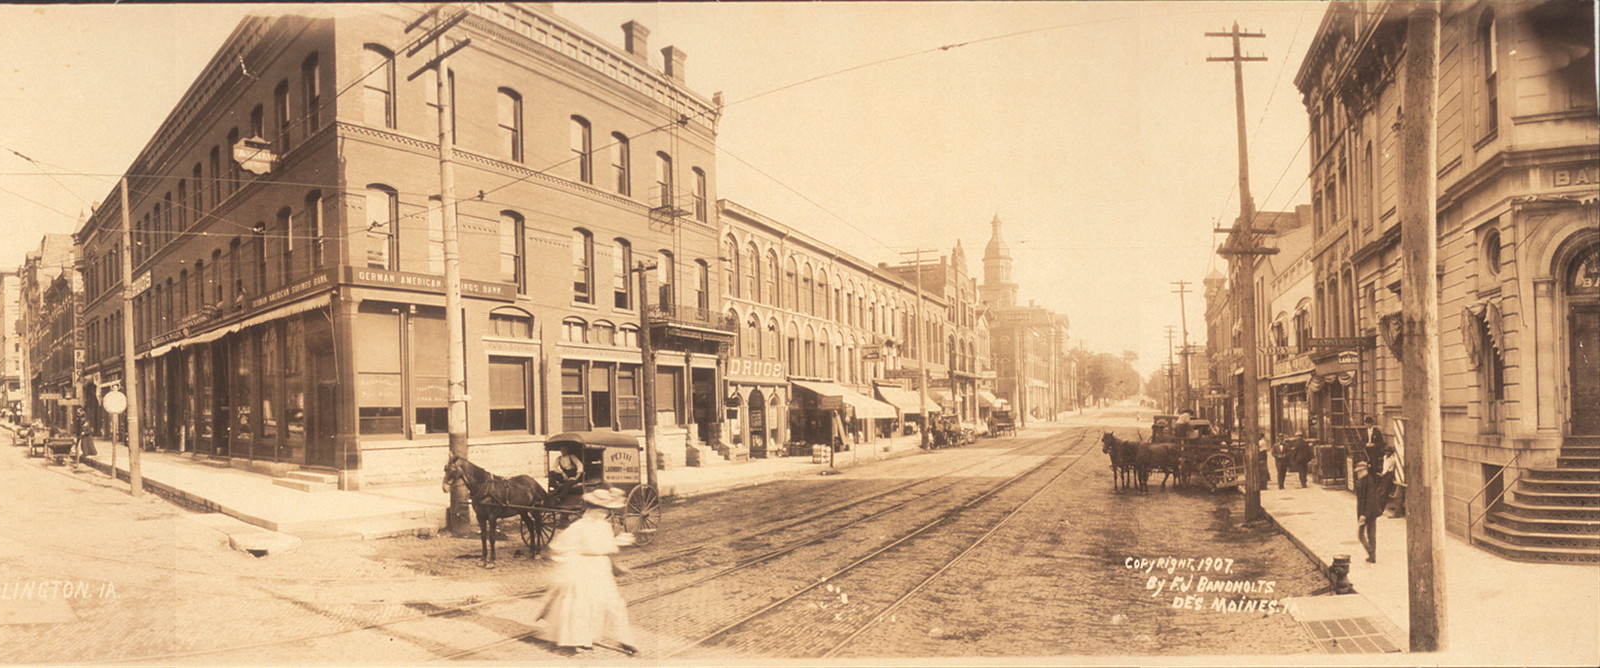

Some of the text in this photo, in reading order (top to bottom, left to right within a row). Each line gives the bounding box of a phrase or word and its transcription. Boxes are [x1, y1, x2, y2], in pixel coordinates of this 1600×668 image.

[359, 271, 395, 283] GERMAN
[400, 276, 442, 288] AMERICAN
[461, 283, 479, 293] INGS
[730, 358, 782, 377] DRUGS
